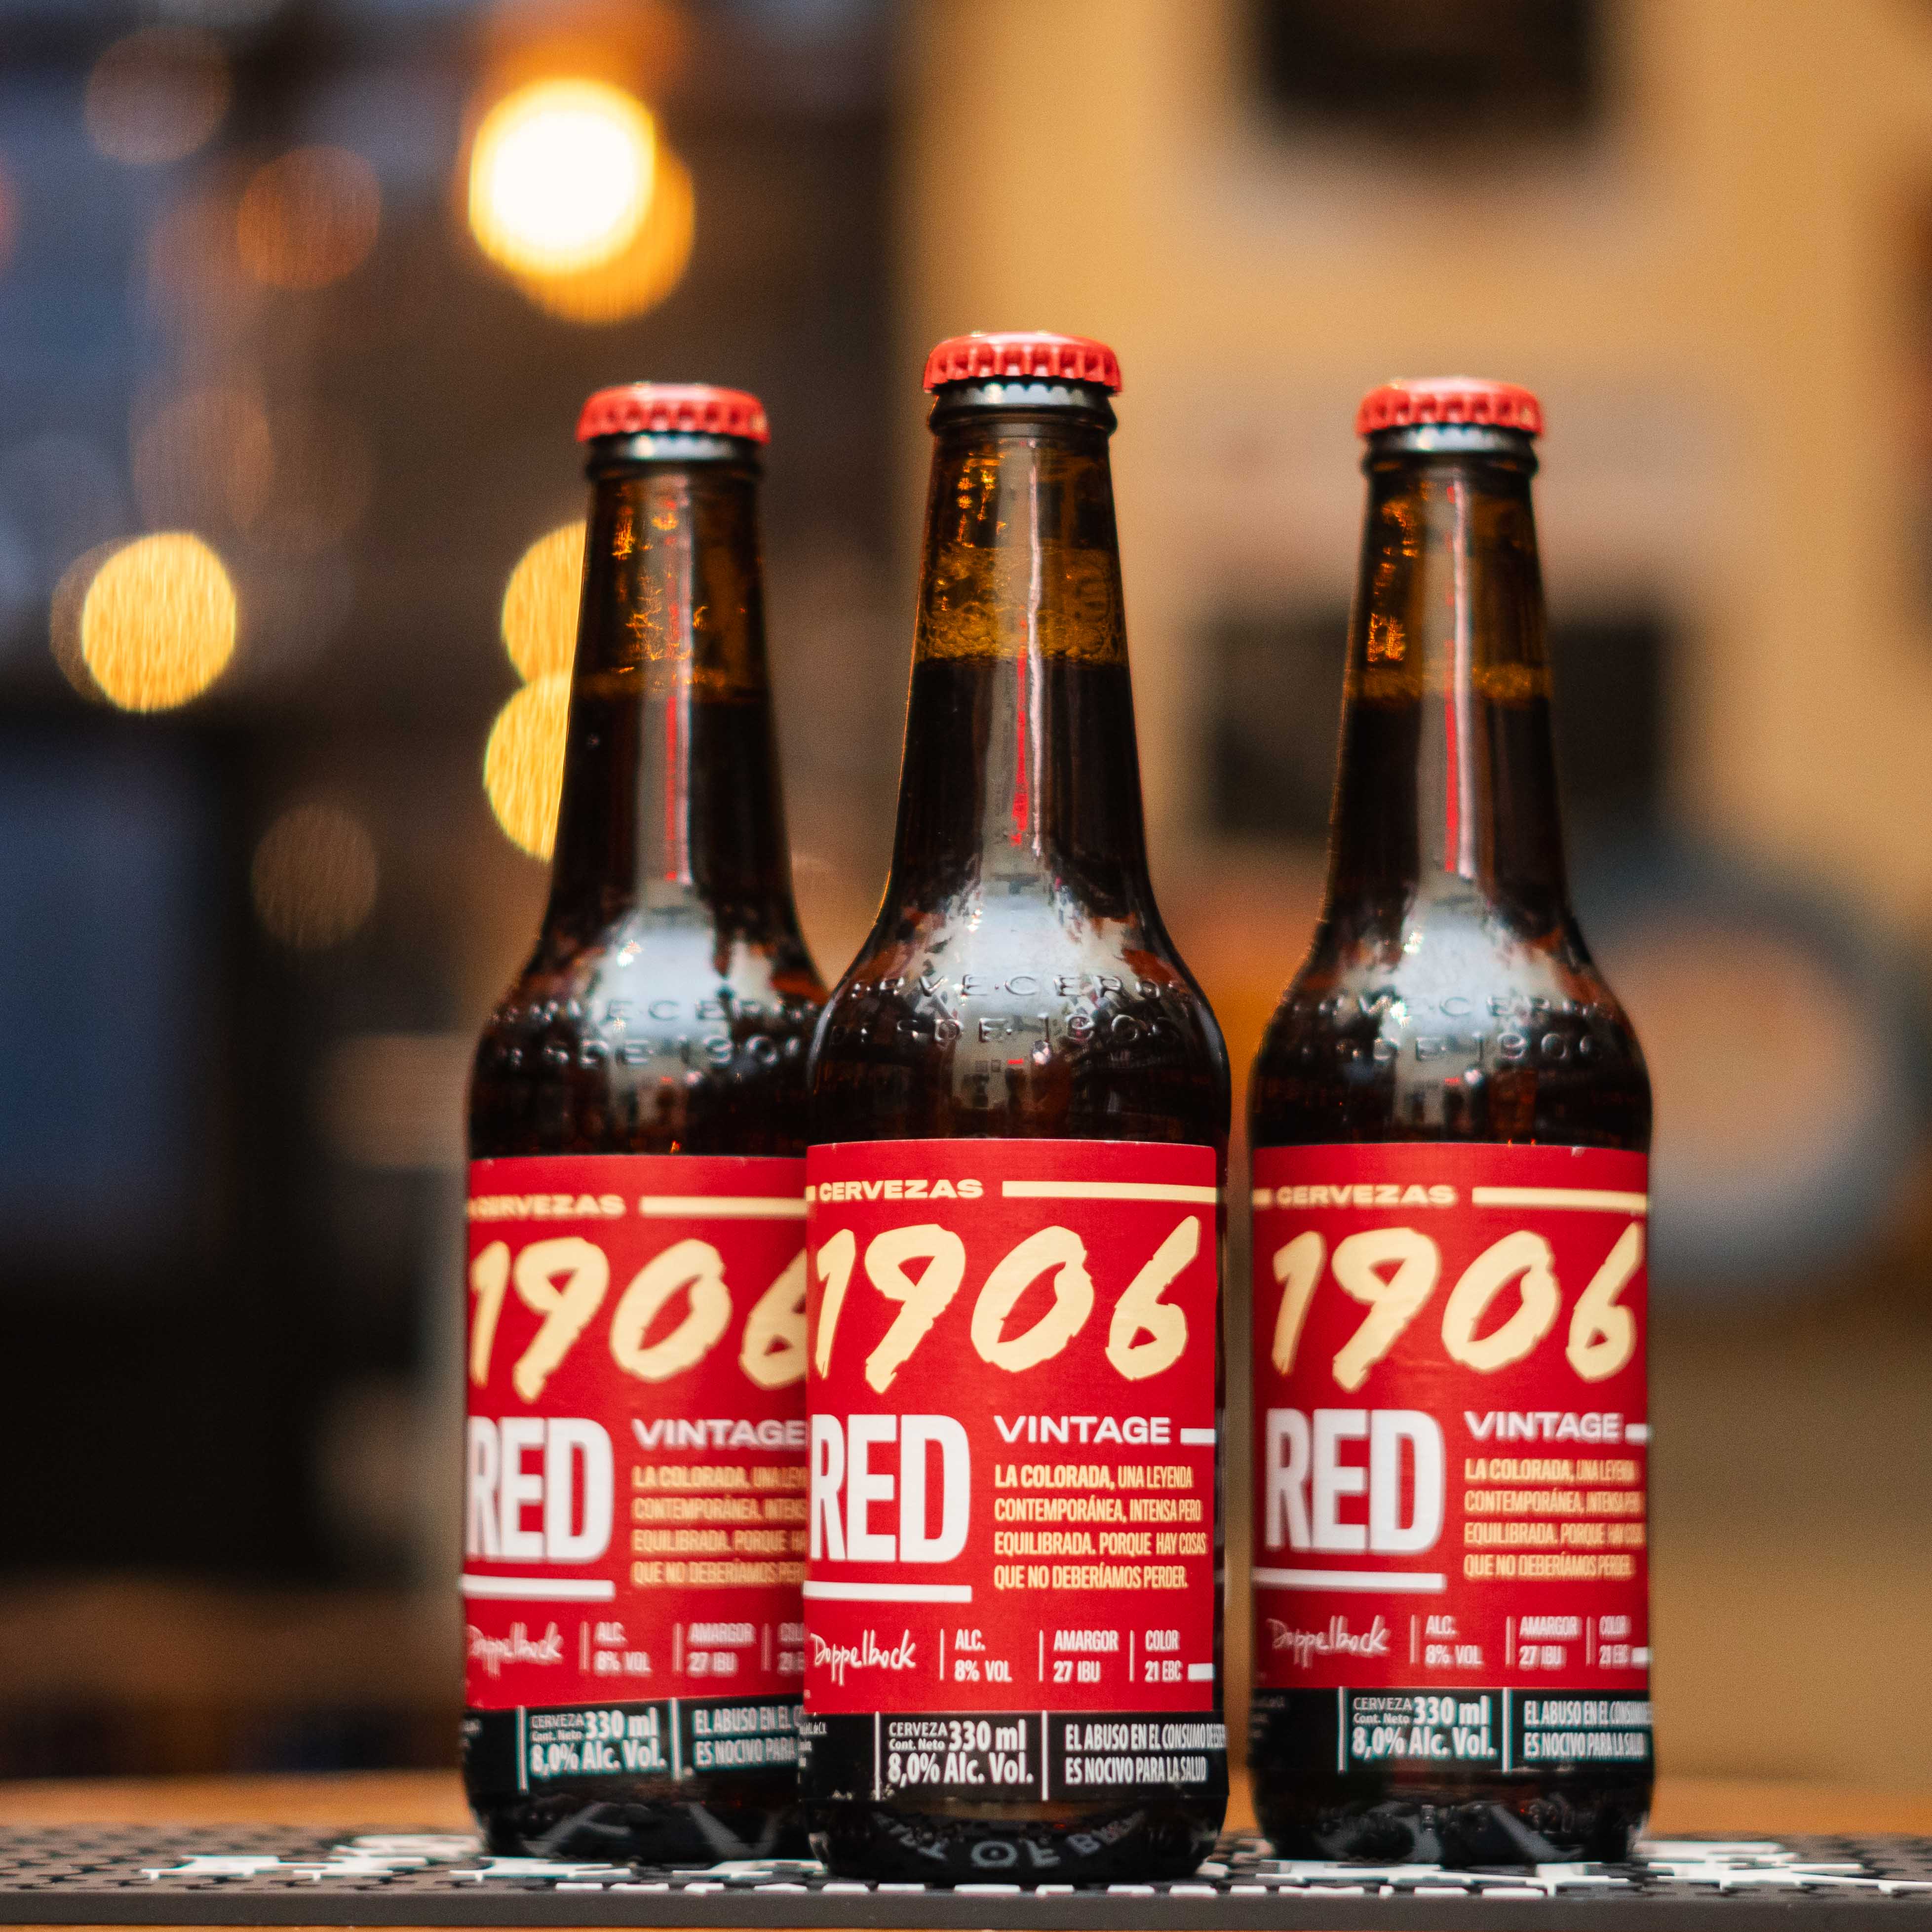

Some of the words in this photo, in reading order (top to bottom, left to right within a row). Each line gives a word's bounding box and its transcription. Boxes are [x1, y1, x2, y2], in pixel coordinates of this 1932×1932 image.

[820, 1179, 983, 1201] CERVEZAS
[1276, 1185, 1456, 1208] CERVEZAS
[816, 1215, 1201, 1394] 1906
[1272, 1222, 1645, 1393] 1906
[469, 1237, 806, 1404] 1906
[632, 1419, 806, 1450] VINTAGE
[993, 1415, 1172, 1444] VINTAGE
[1464, 1410, 1624, 1442] VINTAGE
[994, 1464, 1018, 1488] LA
[1020, 1465, 1115, 1490] COLORADA,
[1118, 1466, 1145, 1489] UNA
[1146, 1466, 1194, 1489] LEYENDA
[1265, 1407, 1446, 1555] RED
[1465, 1458, 1487, 1482] LA
[468, 1416, 614, 1562] RED
[810, 1414, 971, 1563] RED
[994, 1495, 1127, 1523] CONTEMPORÁNEA,
[1129, 1499, 1177, 1522] INTENSA
[1178, 1500, 1203, 1522] PERO
[994, 1532, 1096, 1556] EQUILIBRADA.
[1099, 1532, 1152, 1557] PORQUE
[1156, 1532, 1179, 1555] HAY
[1179, 1532, 1208, 1555] COSAS
[994, 1565, 1025, 1590] QUE
[1028, 1565, 1049, 1589] NO
[1052, 1562, 1141, 1589] DEBERÍAMOS
[1143, 1566, 1189, 1589] PERDER.
[1463, 1554, 1497, 1578] QUE
[1497, 1554, 1516, 1578] NO
[955, 1628, 986, 1651] ALC.
[1145, 1629, 1180, 1651] COLOR
[1425, 1615, 1458, 1638] ALC.
[1053, 1630, 1119, 1652] AMARGOR
[1266, 1615, 1391, 1669] Doppelbock
[810, 1628, 916, 1686] Doppelbock
[1425, 1644, 1452, 1668] 8%
[1454, 1644, 1485, 1668] VOL
[1519, 1645, 1540, 1669] 27
[1540, 1645, 1567, 1669] IBU
[955, 1660, 980, 1682] 8%
[985, 1661, 1012, 1682] VOL
[1053, 1660, 1074, 1683] 27
[1077, 1660, 1101, 1683] IBU
[1144, 1660, 1160, 1683] 21
[1161, 1660, 1182, 1682] EBC
[1352, 1697, 1412, 1711] CERVEZA
[1413, 1696, 1456, 1725] 330
[1458, 1695, 1491, 1725] ml
[1524, 1700, 1540, 1726] EL
[1541, 1700, 1582, 1726] ABUSO
[1584, 1700, 1598, 1726] EN
[1599, 1700, 1609, 1726] EL
[585, 1710, 624, 1740] 330
[628, 1706, 658, 1738] ml
[694, 1709, 712, 1736] EL
[713, 1706, 757, 1734] ABUSO
[889, 1722, 948, 1738] CERVEZA
[1352, 1712, 1381, 1725] Cont.
[1383, 1713, 1410, 1725] Neto
[889, 1738, 916, 1752] Cont.
[918, 1738, 946, 1752] Neto
[949, 1720, 992, 1752] 330
[995, 1718, 1027, 1752] ml
[1065, 1723, 1083, 1750] EL
[1084, 1723, 1129, 1750] ABUSO
[1130, 1723, 1148, 1750] EN
[1149, 1723, 1161, 1750] EL
[1161, 1723, 1206, 1749] CONSUMO
[1352, 1726, 1406, 1761] 8,0%
[1408, 1726, 1450, 1756] Alc.
[1452, 1726, 1496, 1757] Vol.
[1524, 1732, 1540, 1758] ES
[1541, 1732, 1586, 1758] NOCIVO
[530, 1742, 580, 1778] 8,0%
[582, 1739, 620, 1773] Alc.
[622, 1737, 668, 1770] Vol.
[694, 1740, 713, 1768] ES
[714, 1738, 763, 1766] NOCIVO
[888, 1752, 941, 1789] 8,0%
[943, 1751, 985, 1784] Alc.
[988, 1751, 1034, 1784] Vol.
[1065, 1756, 1083, 1785] ES
[1084, 1756, 1134, 1784] NOCIVO
[1135, 1756, 1166, 1784] PARA
[1166, 1756, 1180, 1783] LA
[1180, 1756, 1208, 1783] SALUD
